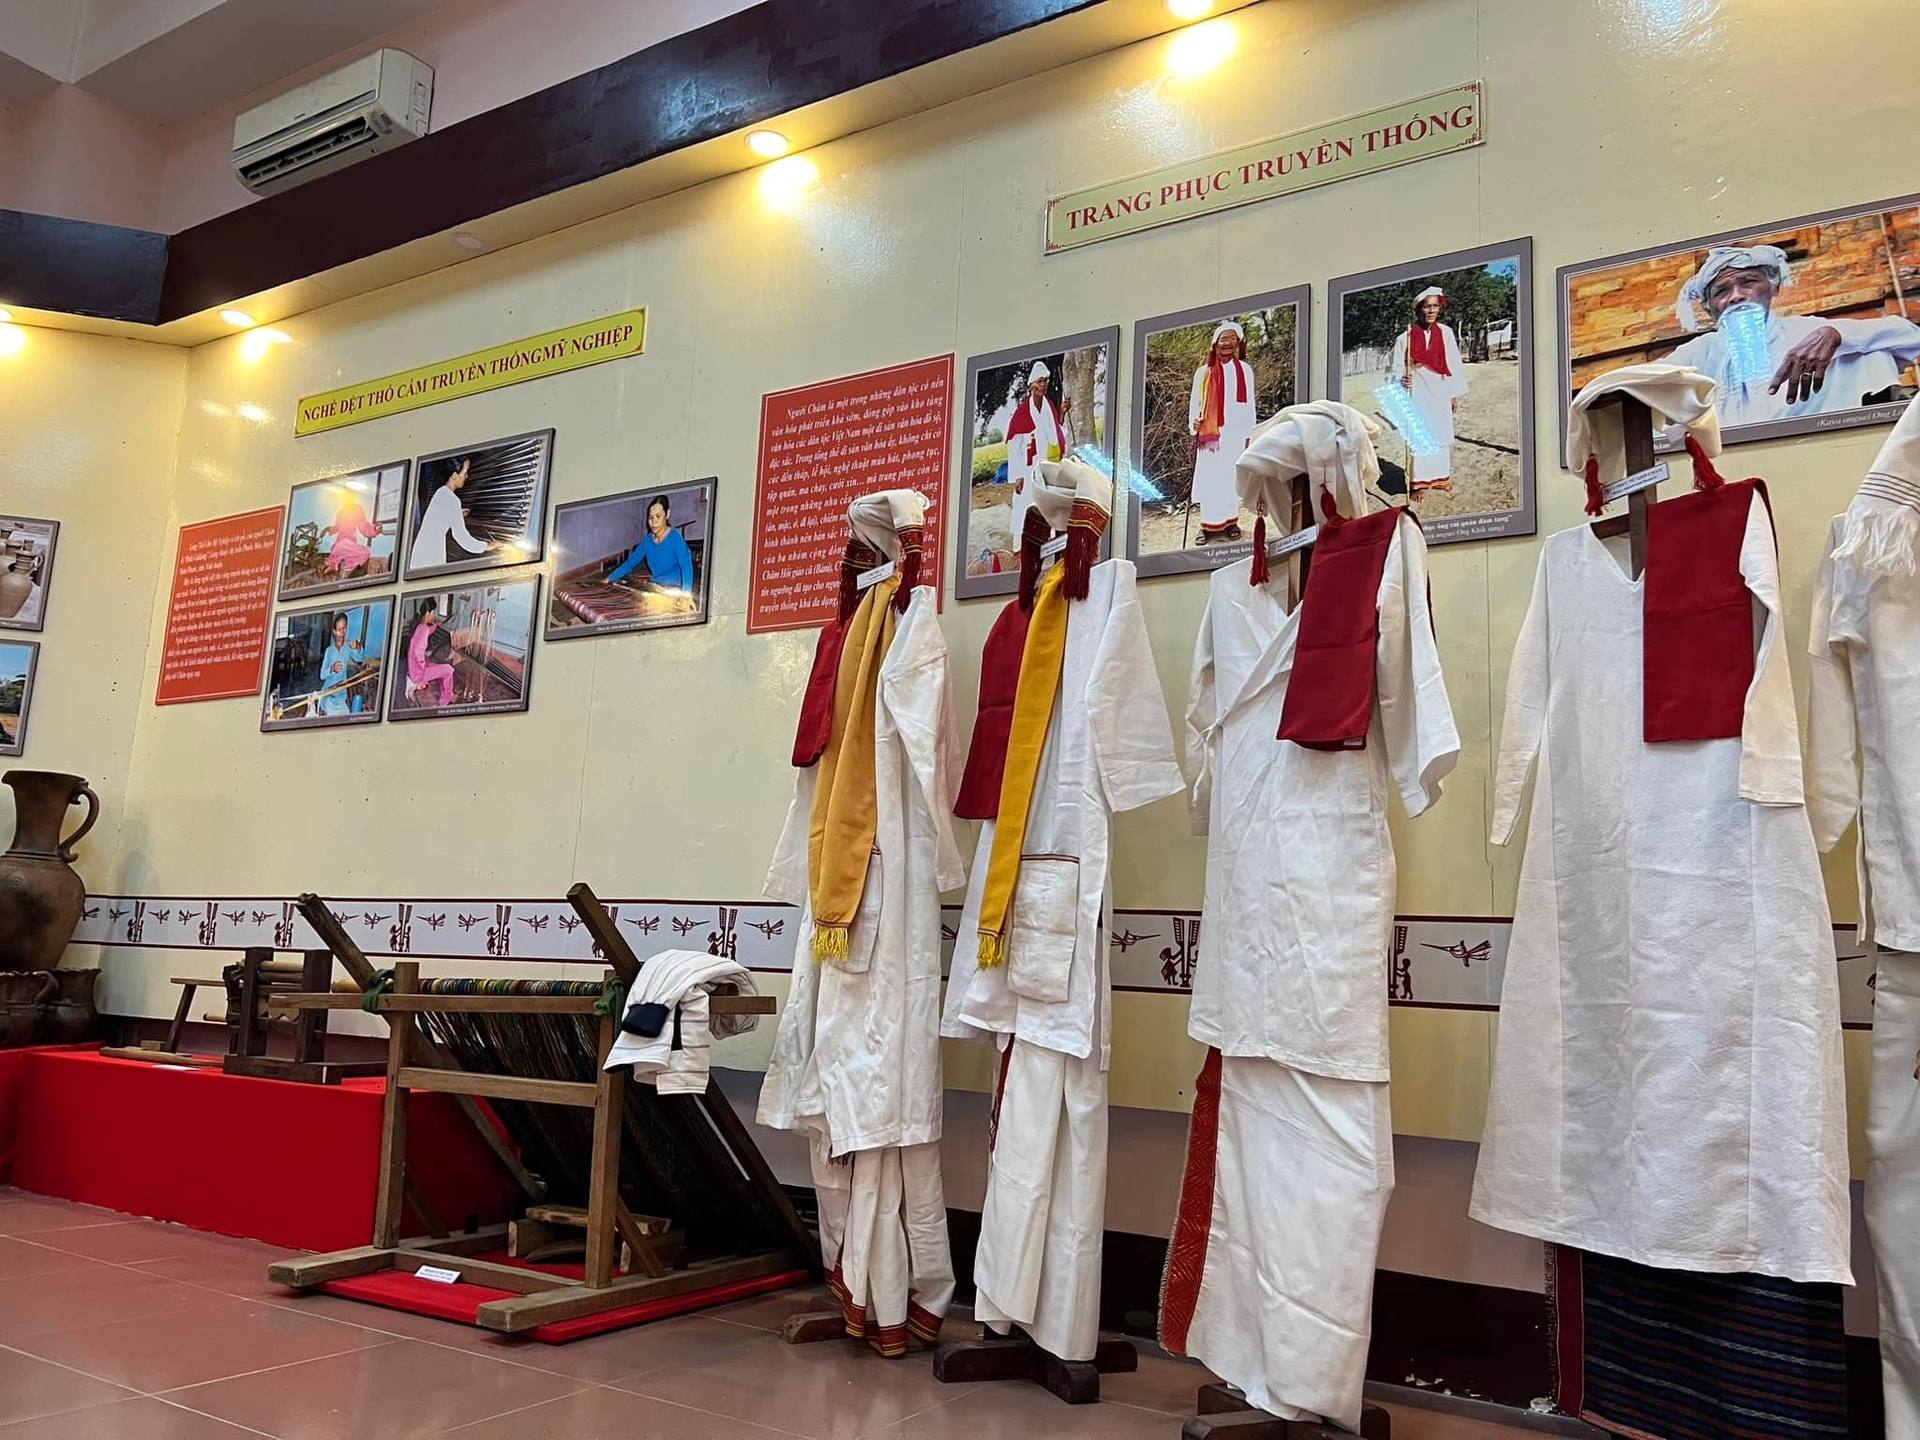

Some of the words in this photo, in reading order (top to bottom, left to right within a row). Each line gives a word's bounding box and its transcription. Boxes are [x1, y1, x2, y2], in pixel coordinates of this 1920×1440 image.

[1066, 191, 1152, 230] TRANG
[1160, 170, 1232, 202] PHỤC
[1238, 138, 1354, 186] TRUYỀN
[1362, 104, 1475, 154] THỐNG
[302, 399, 337, 423] NGHỀ
[339, 395, 367, 415] DỆT
[431, 362, 487, 392] TRUYỀN
[571, 325, 634, 355] NGHIỆP
